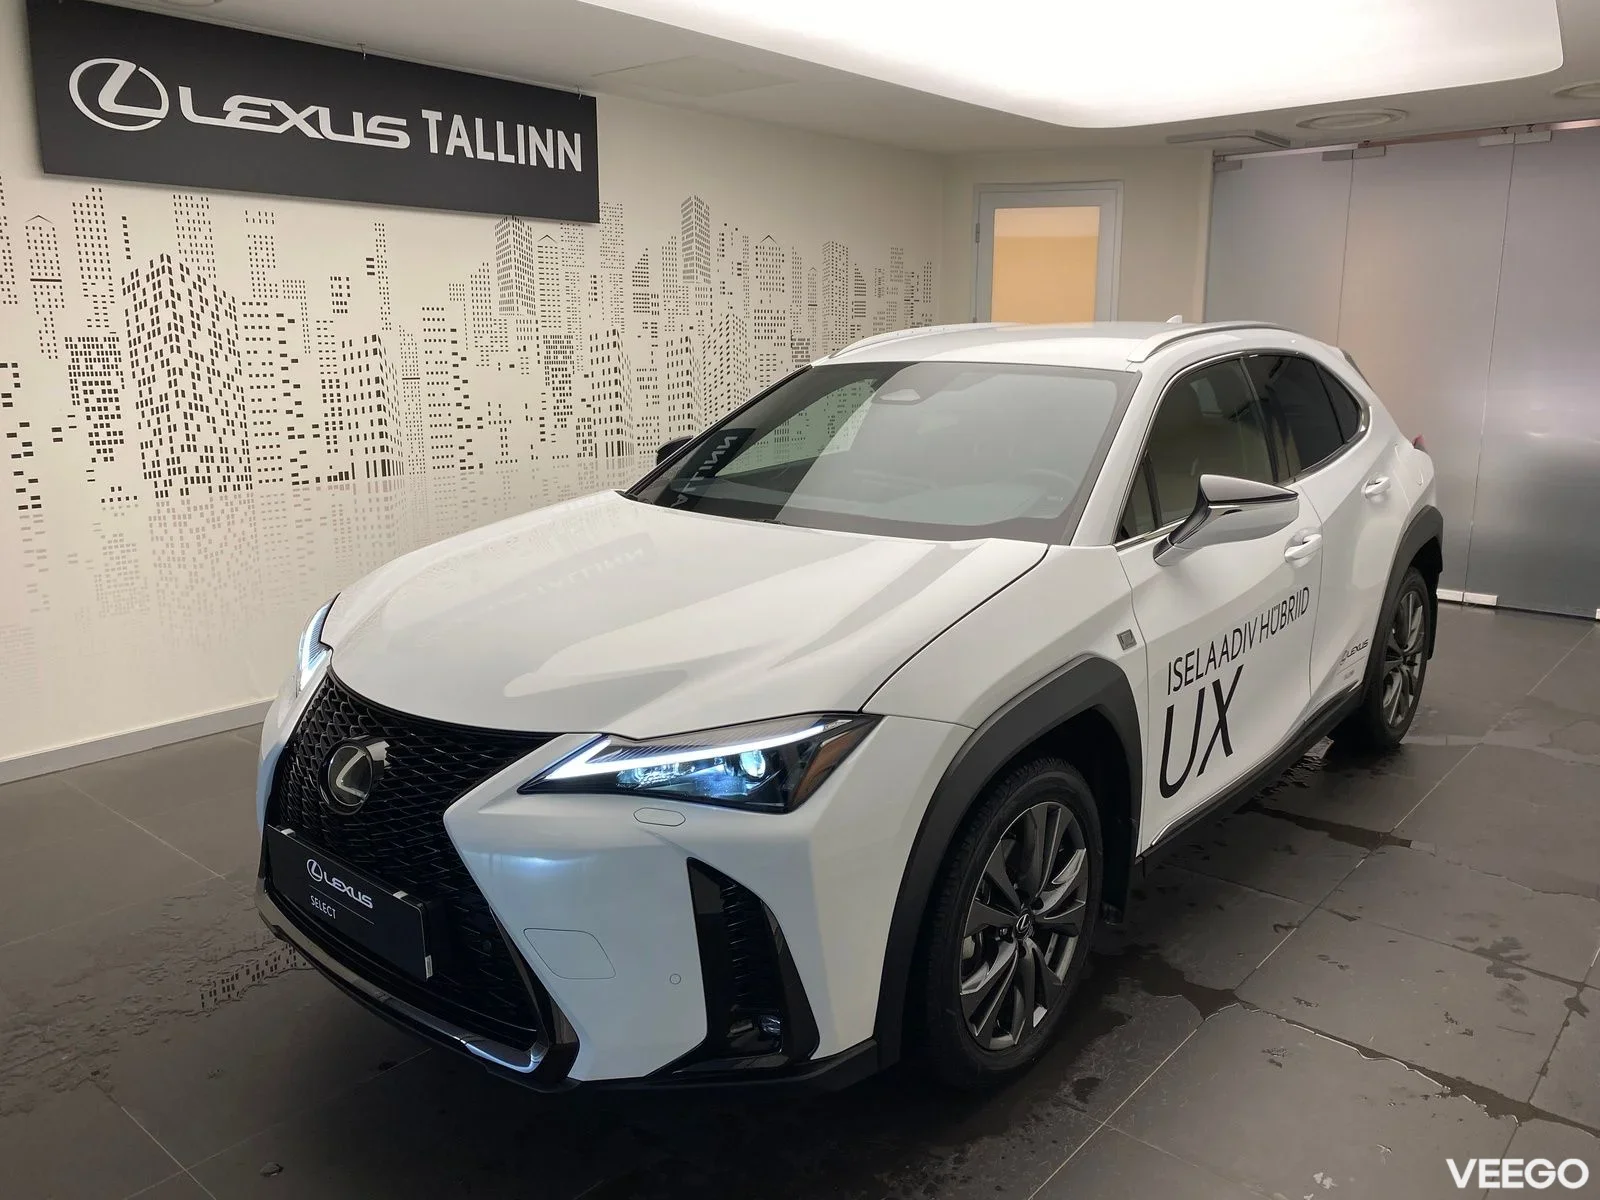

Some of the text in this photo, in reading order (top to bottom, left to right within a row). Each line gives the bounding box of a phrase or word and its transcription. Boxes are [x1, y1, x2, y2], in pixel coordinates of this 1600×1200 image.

[179, 86, 410, 149] LEXUS
[421, 109, 582, 172] TALLINN
[1167, 586, 1310, 695] ISELAADIV HÜBRIID
[1159, 664, 1244, 799] UX
[310, 895, 336, 919] SELECT
[324, 871, 373, 909] LEXUS
